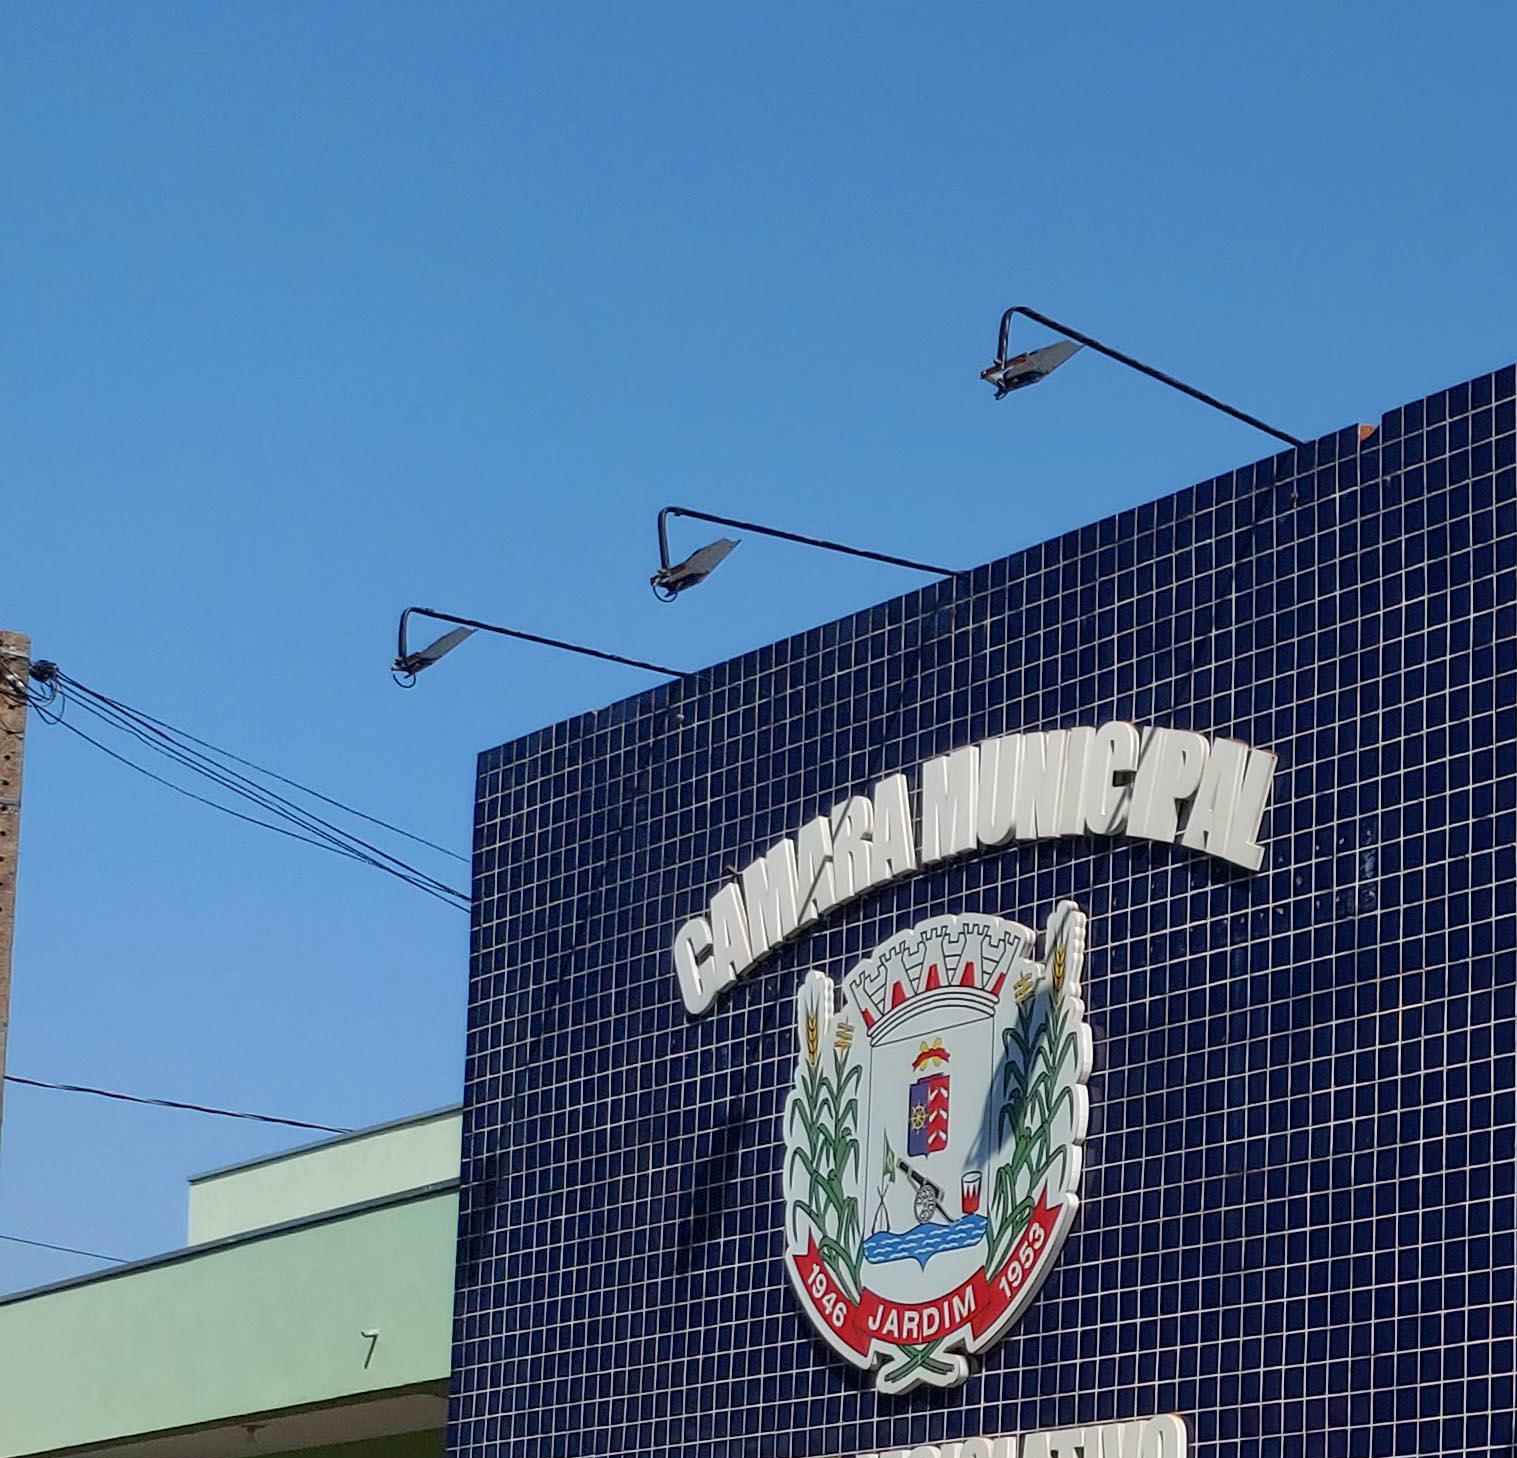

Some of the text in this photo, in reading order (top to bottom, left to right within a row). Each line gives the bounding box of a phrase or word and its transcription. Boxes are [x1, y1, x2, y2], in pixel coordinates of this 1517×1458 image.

[922, 720, 1278, 871] MUNICIPAL
[808, 1223, 1045, 1339] 1946 JARDIM 1953
